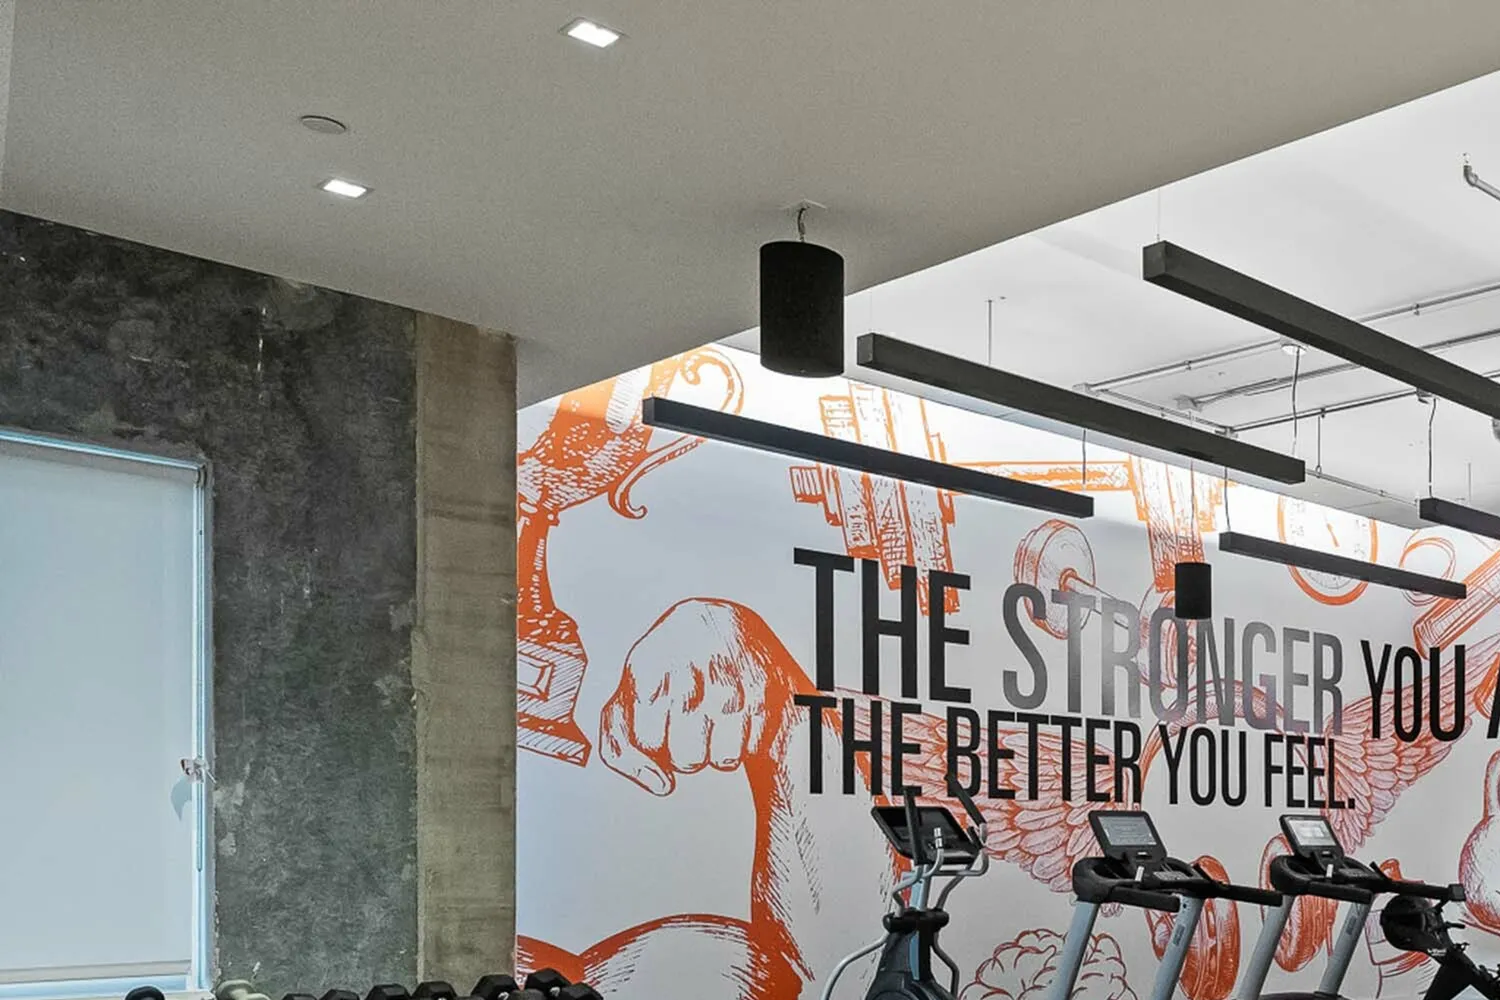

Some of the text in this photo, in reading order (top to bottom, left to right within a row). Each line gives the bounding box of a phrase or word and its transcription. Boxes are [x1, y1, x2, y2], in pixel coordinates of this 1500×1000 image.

[793, 547, 972, 704] THE
[1002, 582, 1344, 737] STRONGER
[1360, 639, 1466, 743] YOU
[794, 694, 1356, 810] THE BETTER YOU FEEL.
